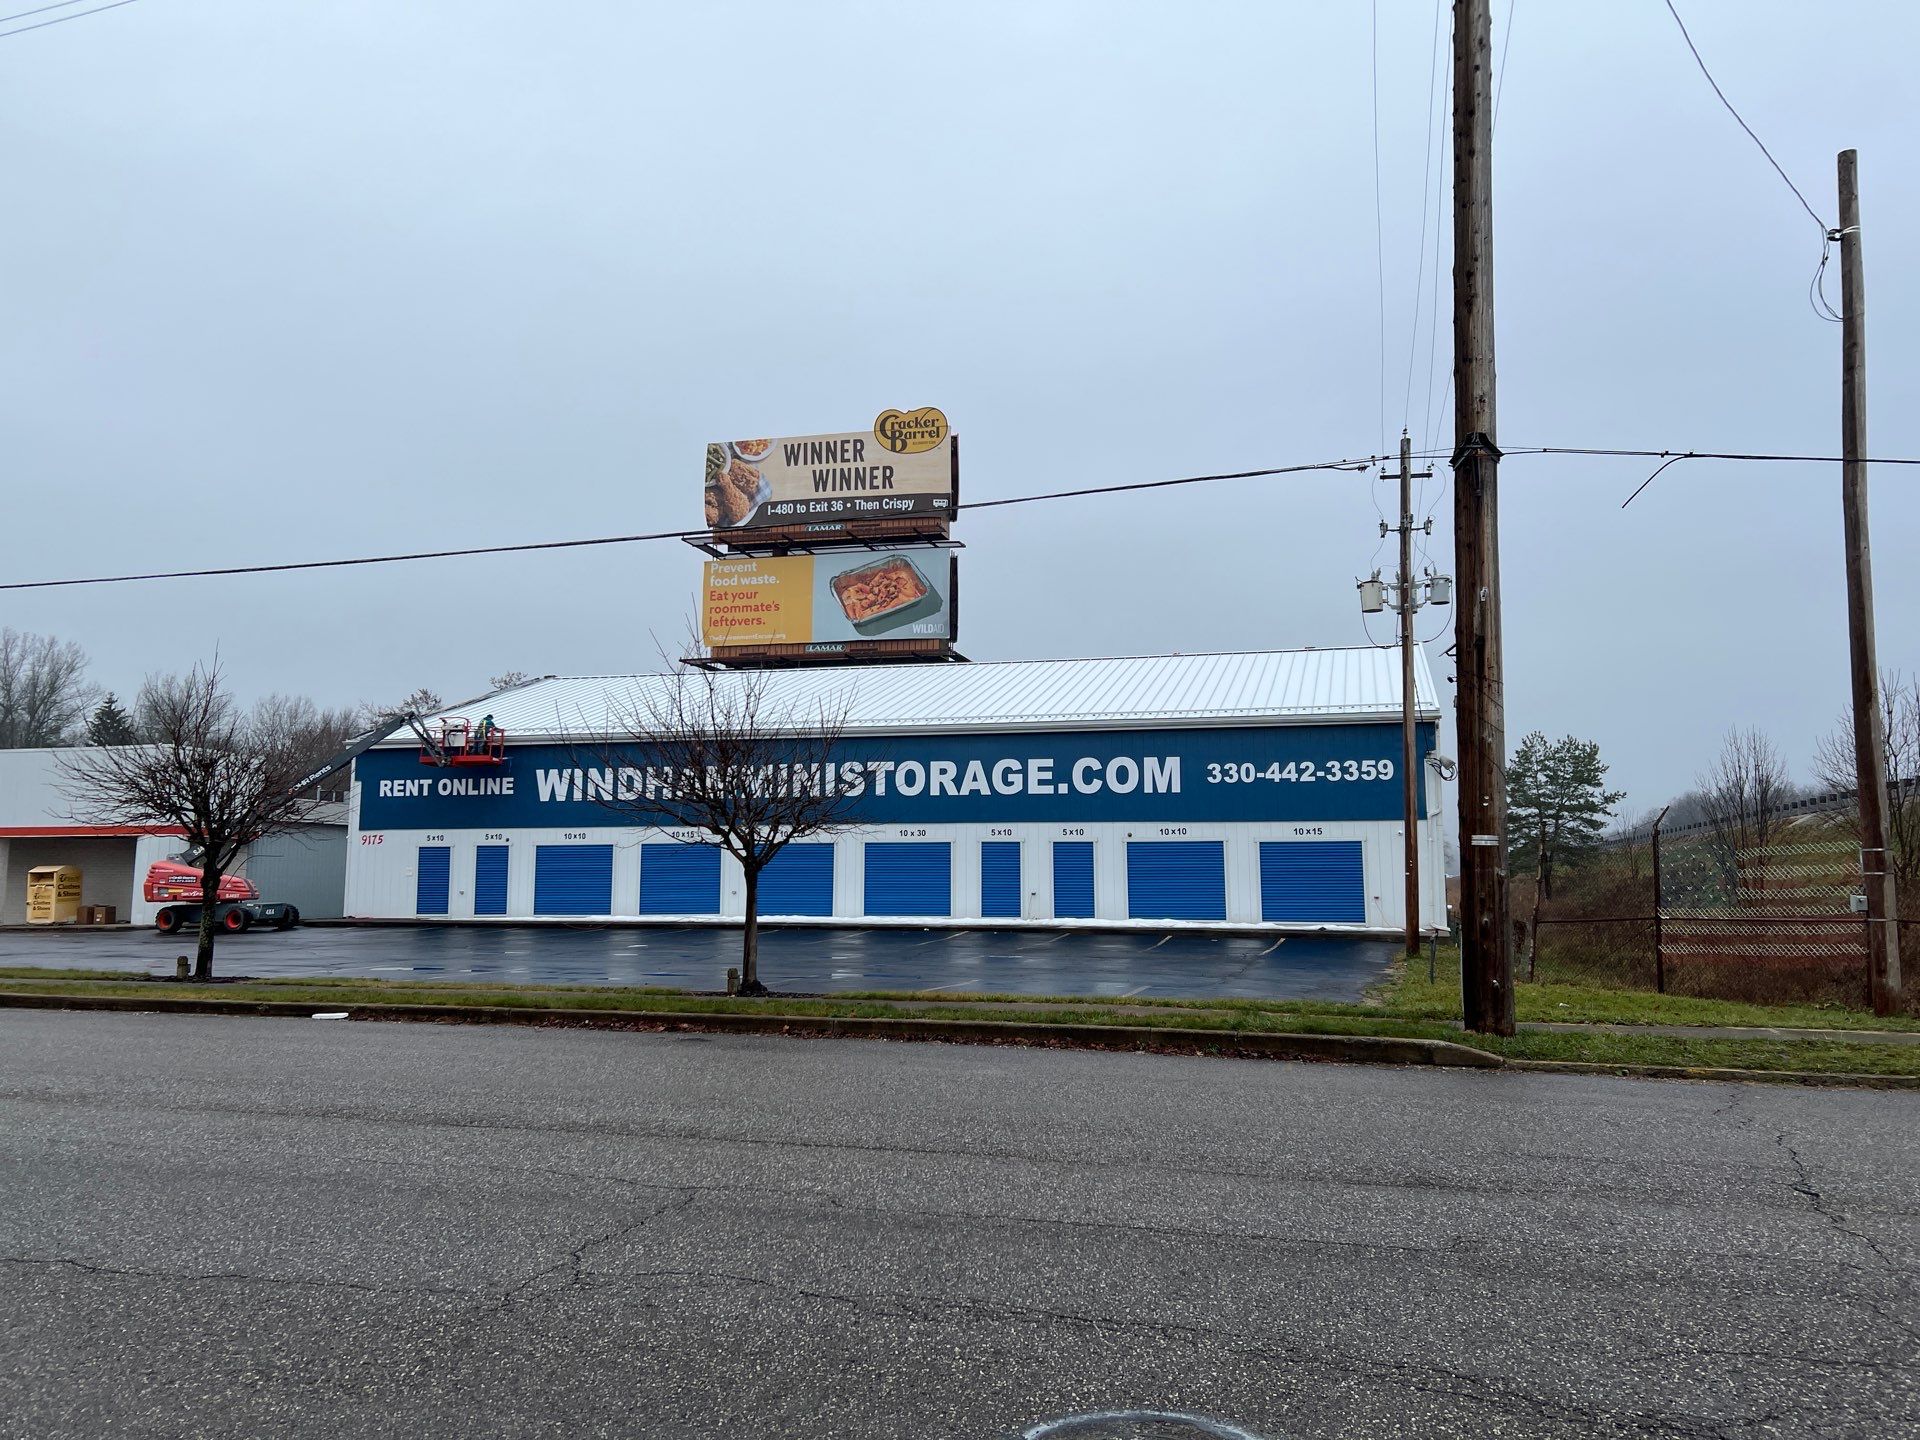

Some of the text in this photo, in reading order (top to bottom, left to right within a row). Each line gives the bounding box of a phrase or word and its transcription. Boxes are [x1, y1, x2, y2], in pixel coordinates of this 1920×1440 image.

[880, 414, 940, 440] Cracker
[890, 427, 940, 453] Barrel
[783, 439, 865, 467] WINNER
[812, 465, 894, 492] WINNER
[767, 498, 914, 515] I-480 to Exit 36 Then Crispy
[808, 523, 842, 532] LAMAR
[710, 561, 757, 574] Prevent
[710, 574, 780, 587] food waste.
[709, 590, 759, 604] Eat your
[709, 600, 780, 614] roommate's
[709, 616, 766, 627] leftovers.
[808, 644, 843, 652] LAMAR
[1206, 759, 1394, 784] 330-442-3359
[379, 777, 514, 797] RENT ONLINE
[361, 834, 384, 846] 9175
